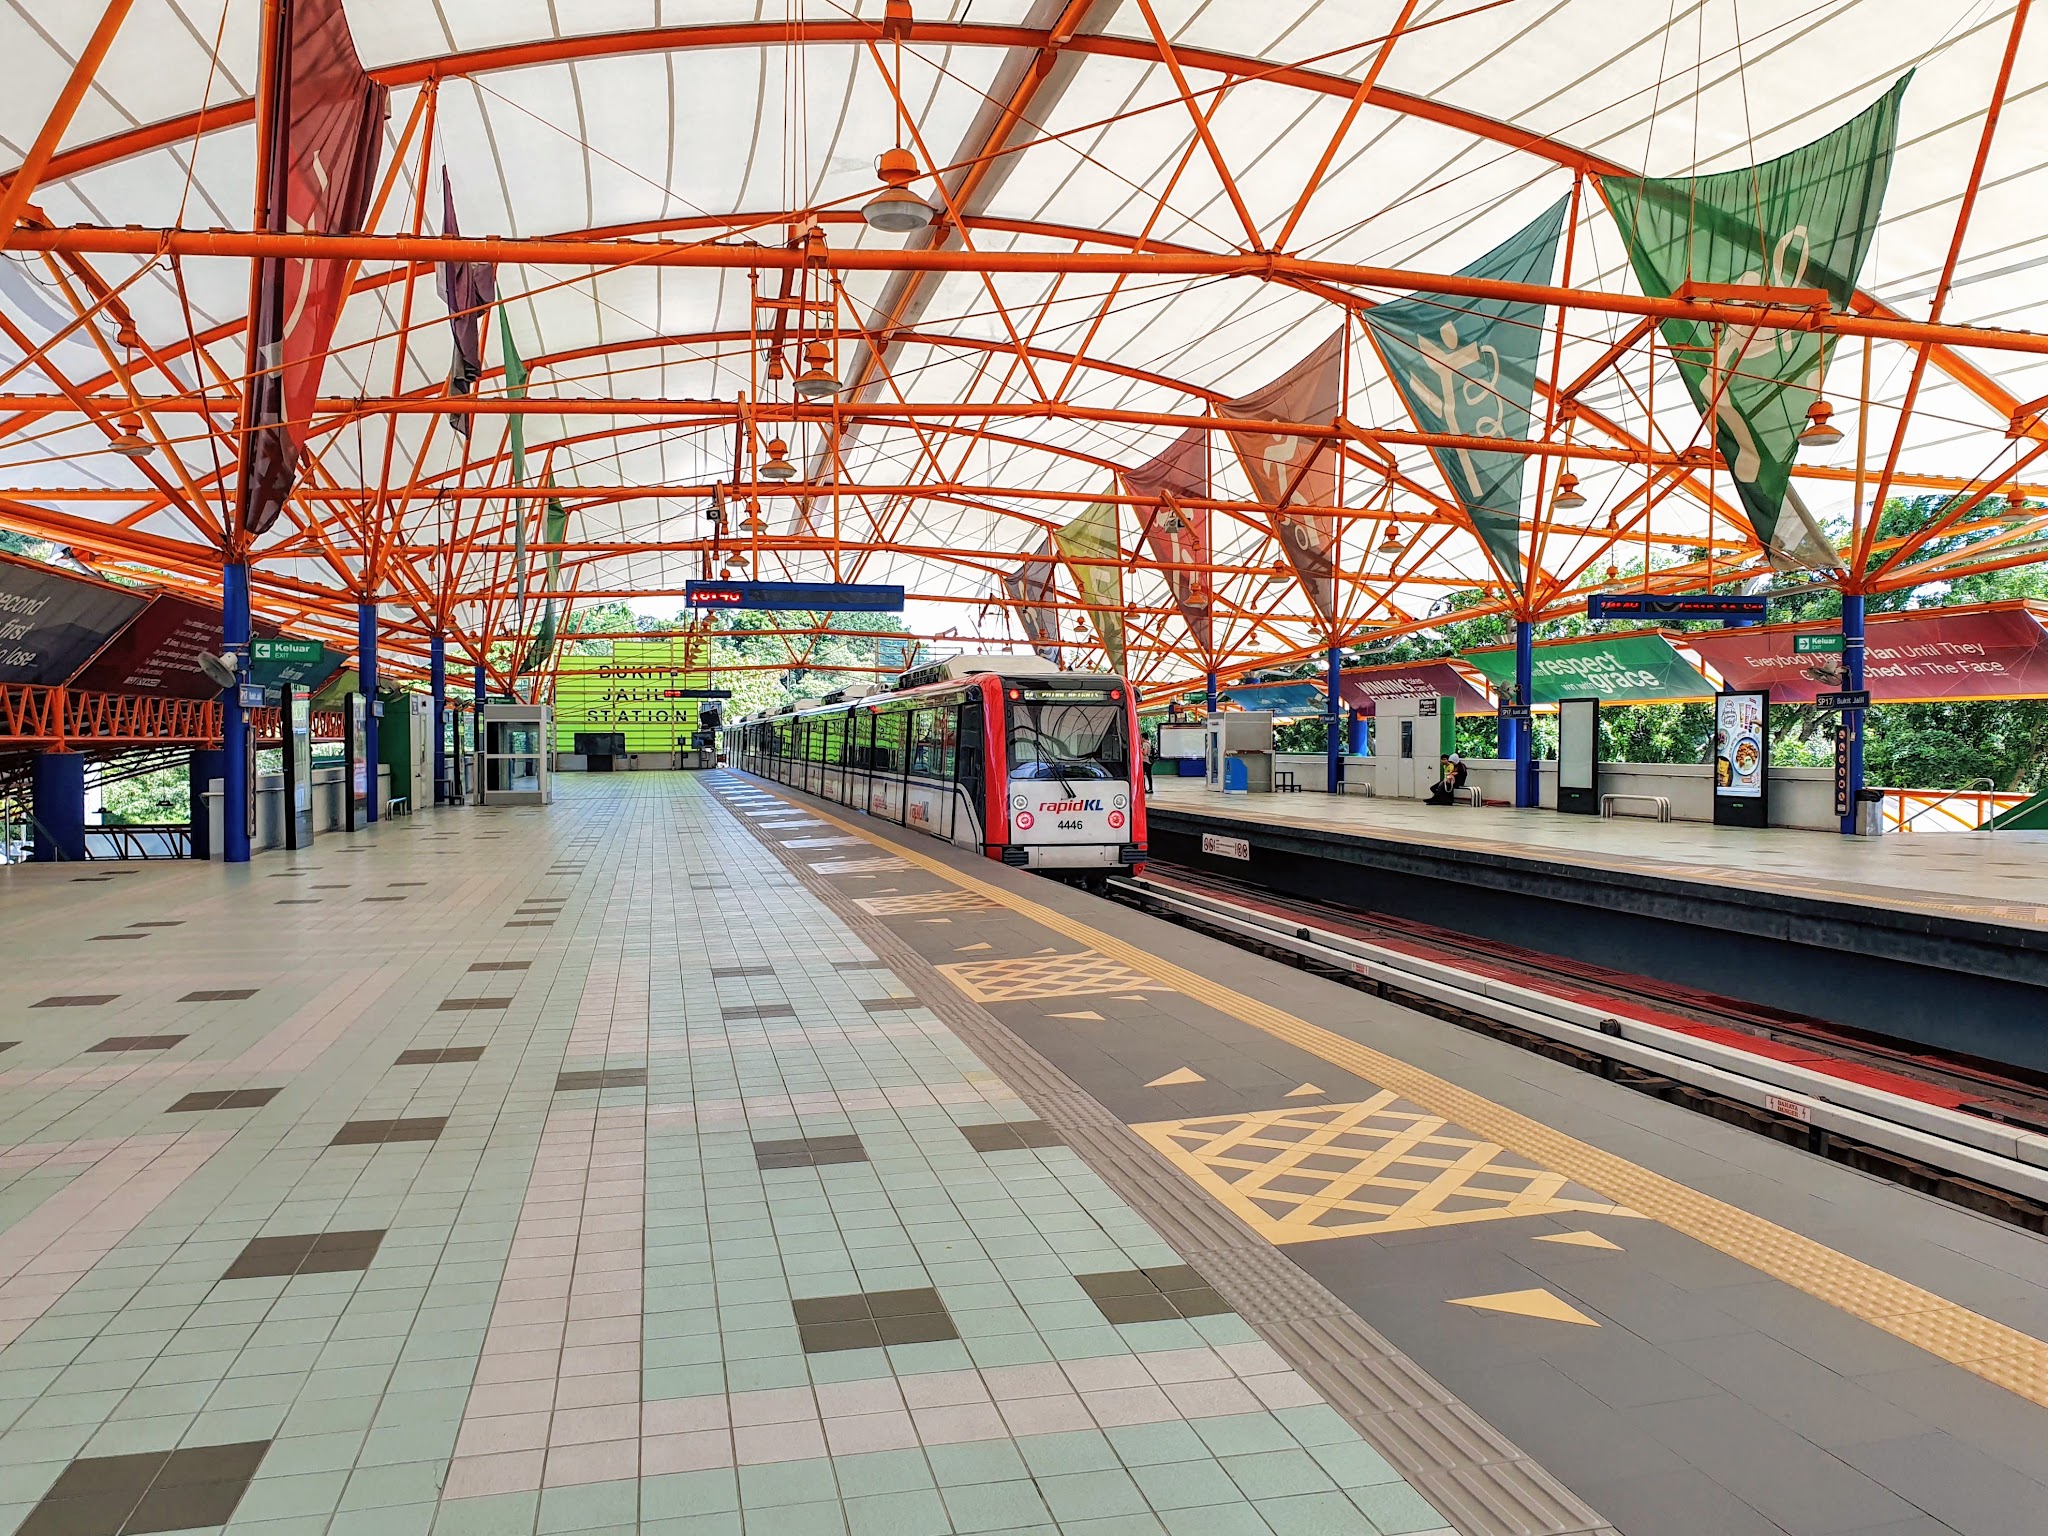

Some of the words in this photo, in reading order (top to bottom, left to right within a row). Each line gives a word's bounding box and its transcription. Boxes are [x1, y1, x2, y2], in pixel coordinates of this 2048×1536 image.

[275, 643, 311, 652] Keluar
[6, 646, 37, 667] lose
[1744, 653, 1815, 668] Everybody
[1899, 644, 1942, 658] Until
[1937, 642, 1986, 656] They
[1535, 651, 1626, 678] respect
[1904, 664, 1926, 676] In
[1920, 662, 1959, 675] The
[1956, 660, 2005, 673] Face
[599, 665, 666, 679] BUKIT
[1354, 678, 1416, 695] WINNING
[1561, 683, 1579, 691] win
[1578, 681, 1597, 690] with
[1587, 669, 1660, 694] grace
[603, 688, 664, 701] JALIL
[1836, 697, 1852, 705] Bukit
[1817, 697, 1833, 706] SP17
[587, 710, 687, 722] STATION
[1039, 799, 1104, 814] rapidKL
[1057, 820, 1083, 830] 4446
